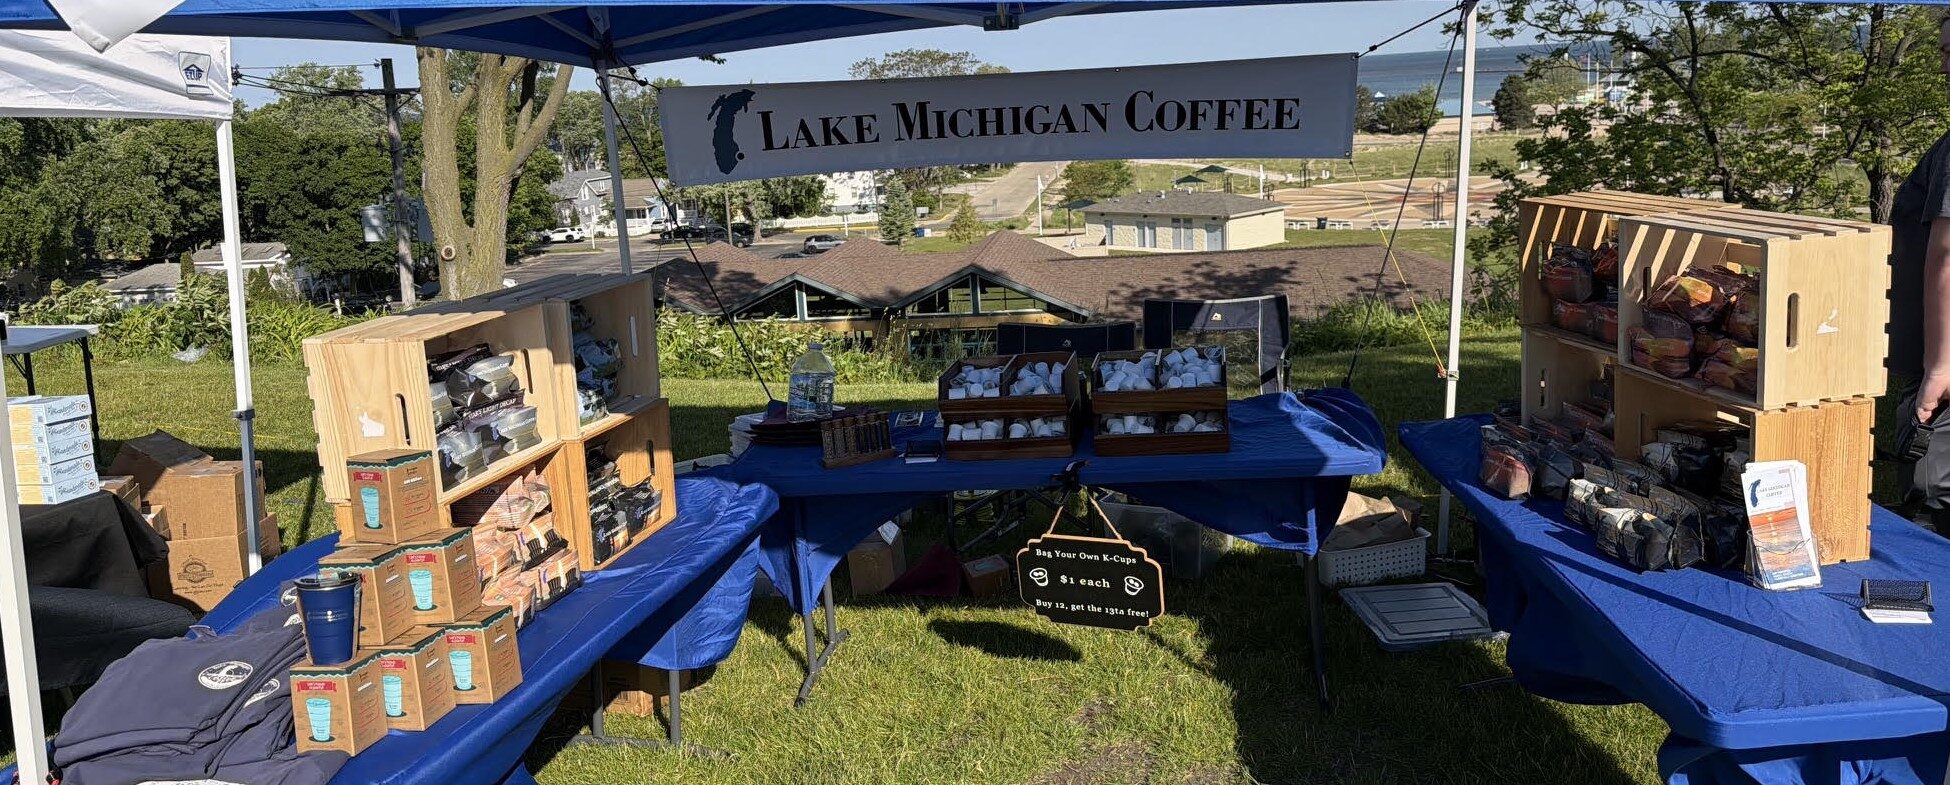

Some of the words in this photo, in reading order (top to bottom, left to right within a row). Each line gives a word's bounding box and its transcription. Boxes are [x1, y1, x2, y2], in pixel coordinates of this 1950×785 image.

[757, 110, 880, 151] LAKE
[892, 101, 1111, 141] MICHIGAN
[1124, 90, 1300, 133] COFFEE
[1035, 548, 1053, 559] Bag
[1054, 549, 1077, 560] Your
[1079, 552, 1100, 561] Own
[1102, 554, 1137, 566] K-Cups
[1060, 574, 1075, 585] $1
[1079, 578, 1111, 589] each
[1035, 598, 1053, 609] Buy
[1055, 602, 1069, 611] 12,
[1070, 604, 1085, 612] get
[1087, 604, 1103, 613] the
[1127, 608, 1150, 619] free!
